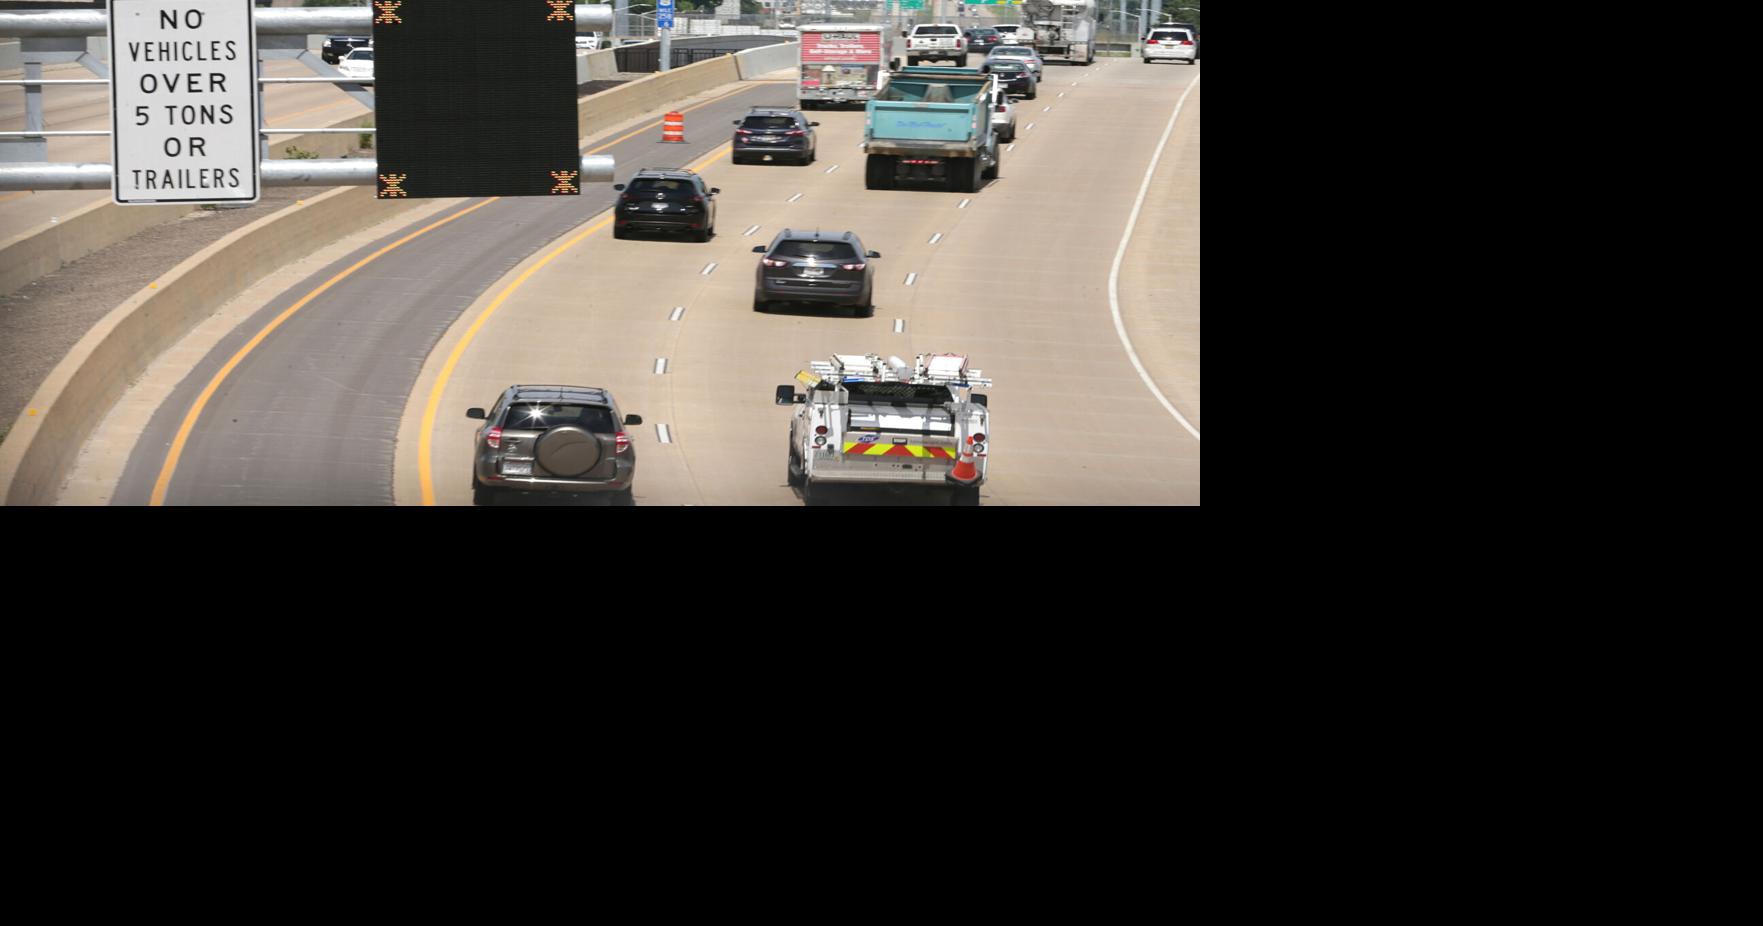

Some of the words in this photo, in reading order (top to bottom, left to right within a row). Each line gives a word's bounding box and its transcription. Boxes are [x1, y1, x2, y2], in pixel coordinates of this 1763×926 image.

[160, 9, 203, 30] NO
[128, 40, 237, 62] VEHICLES
[140, 72, 227, 94] OVER
[135, 105, 150, 126] 5
[164, 104, 234, 126] TONS
[163, 136, 206, 157] OR
[132, 167, 240, 190] TRAILERS
